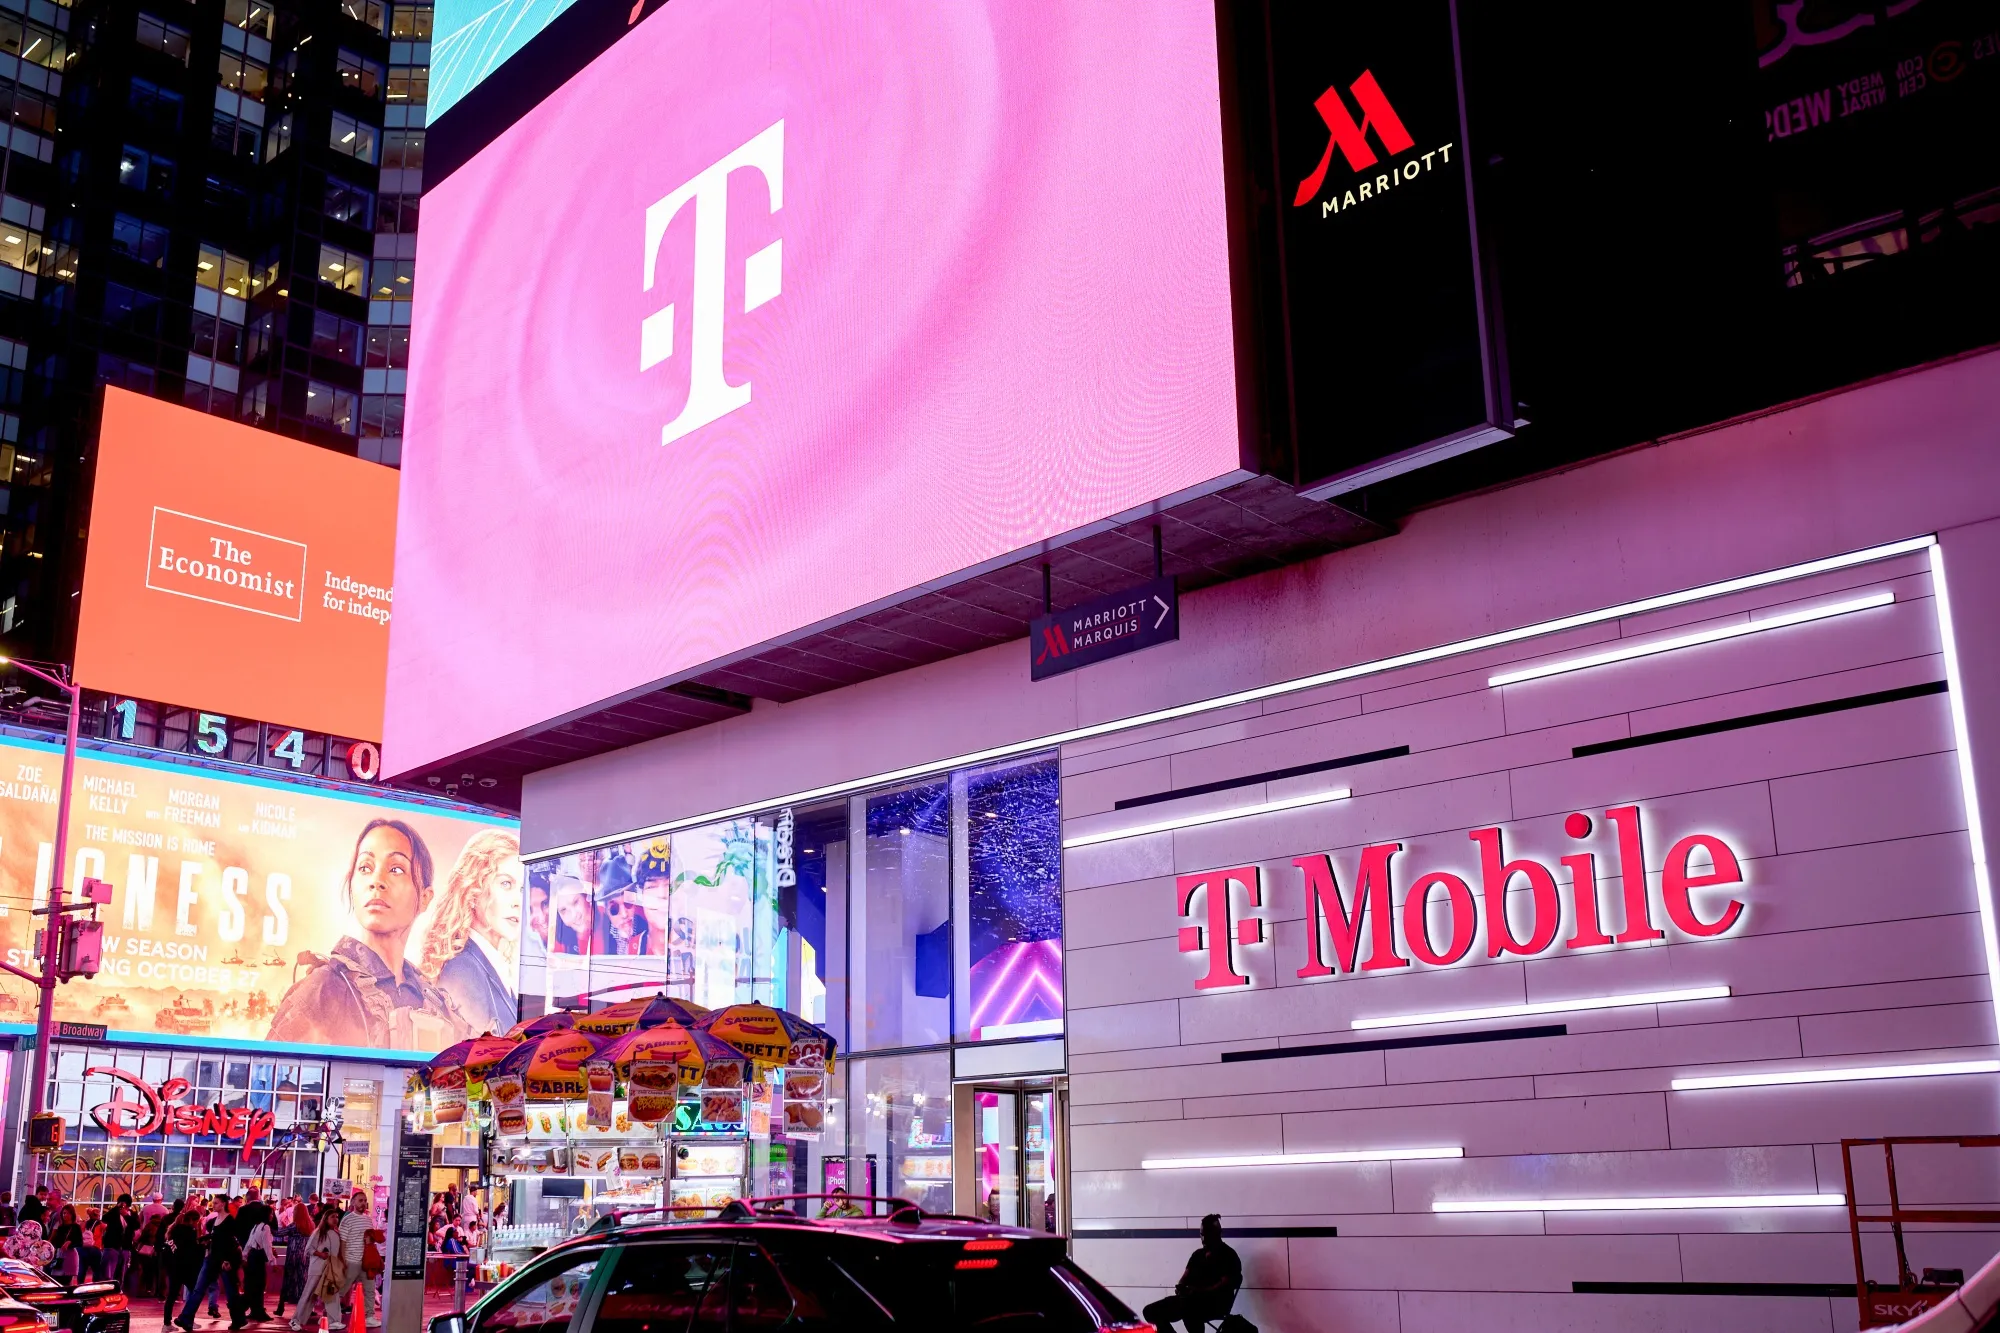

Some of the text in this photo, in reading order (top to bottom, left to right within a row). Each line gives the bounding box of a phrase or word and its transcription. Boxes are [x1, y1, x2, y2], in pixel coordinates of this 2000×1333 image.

[1322, 142, 1453, 219] MARRIOTT
[210, 537, 252, 565] The
[158, 546, 294, 599] Economist
[322, 591, 346, 612] for
[1073, 599, 1147, 632] MARRIOTT
[1074, 619, 1138, 649] MARQUIS
[83, 775, 138, 798] MICHAEL
[89, 796, 129, 814] KELLY
[168, 788, 220, 810] MORGAN
[164, 806, 221, 828] FREEMAN
[255, 802, 296, 822] NICOLE
[85, 824, 215, 857] THE MISSION IS HOME
[252, 819, 297, 839] KIDMAN
[0, 836, 291, 946] IONESS
[1176, 805, 1745, 989] T Mobile
[125, 937, 208, 962] SEASON
[137, 960, 233, 985] OCTOBER
[236, 970, 262, 988] 27
[62, 1024, 105, 1040] Broadway
[540, 1046, 588, 1063] SABRETT
[529, 1081, 585, 1094] SABRE
[828, 1176, 846, 1185] iPhon
